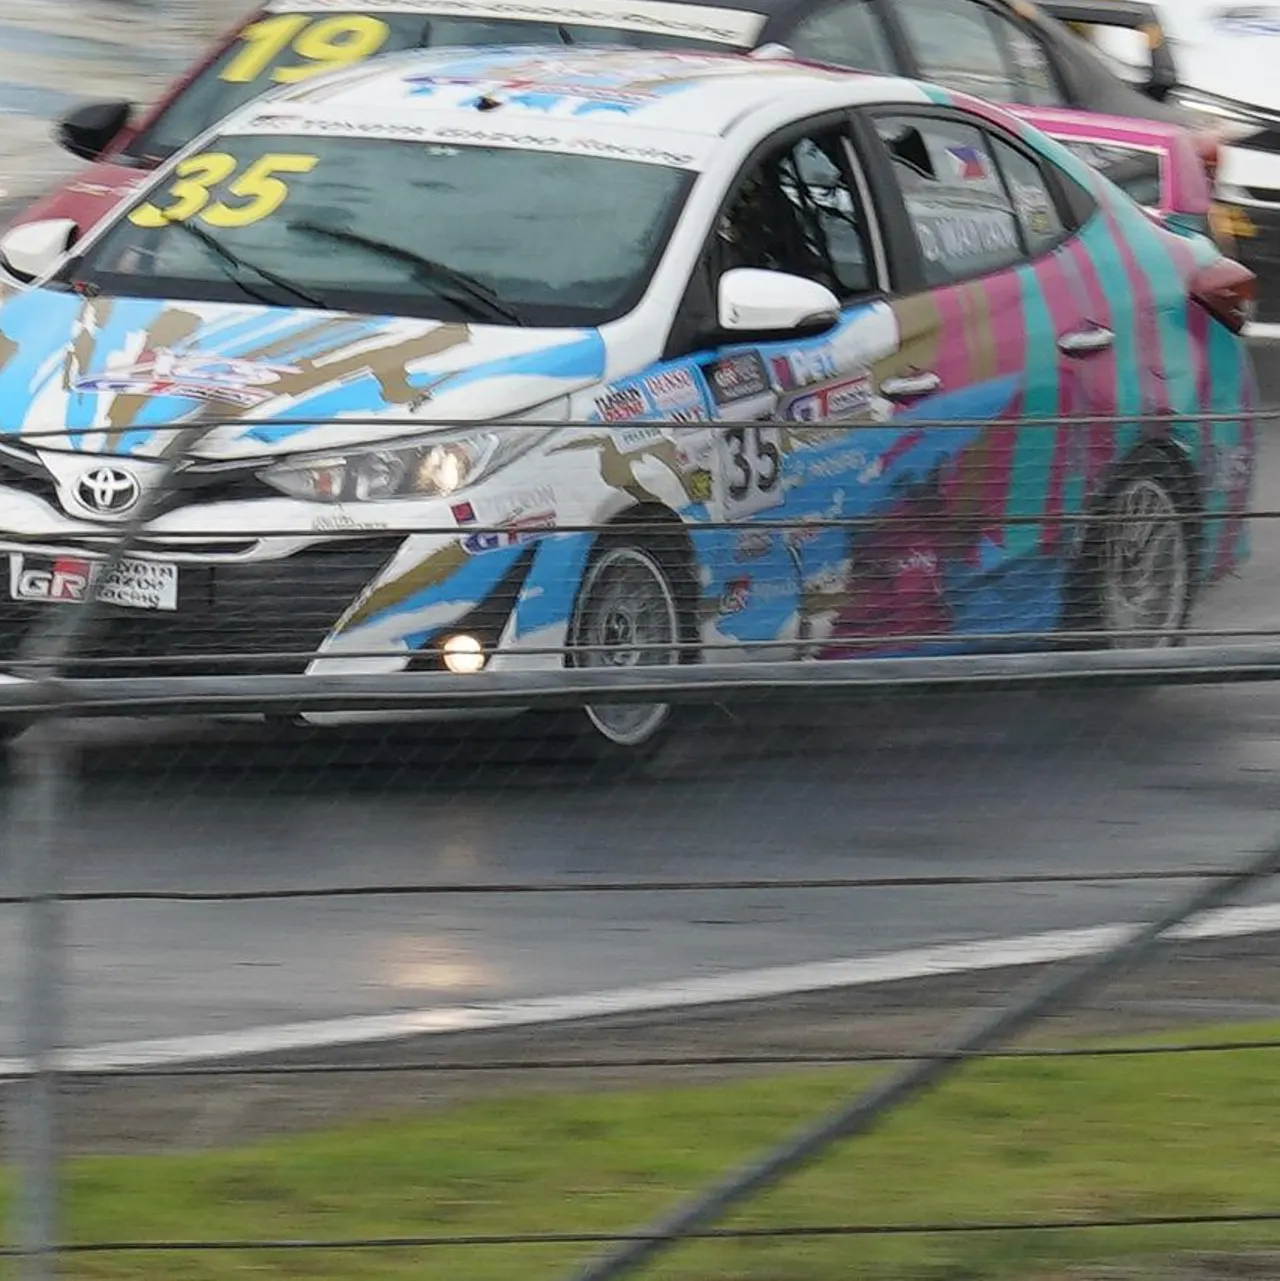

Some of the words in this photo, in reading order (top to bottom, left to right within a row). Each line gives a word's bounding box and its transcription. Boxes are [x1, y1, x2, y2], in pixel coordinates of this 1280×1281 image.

[218, 13, 391, 84] 19
[127, 152, 321, 228] 35
[723, 424, 781, 503] 35
[20, 570, 88, 601] GR
